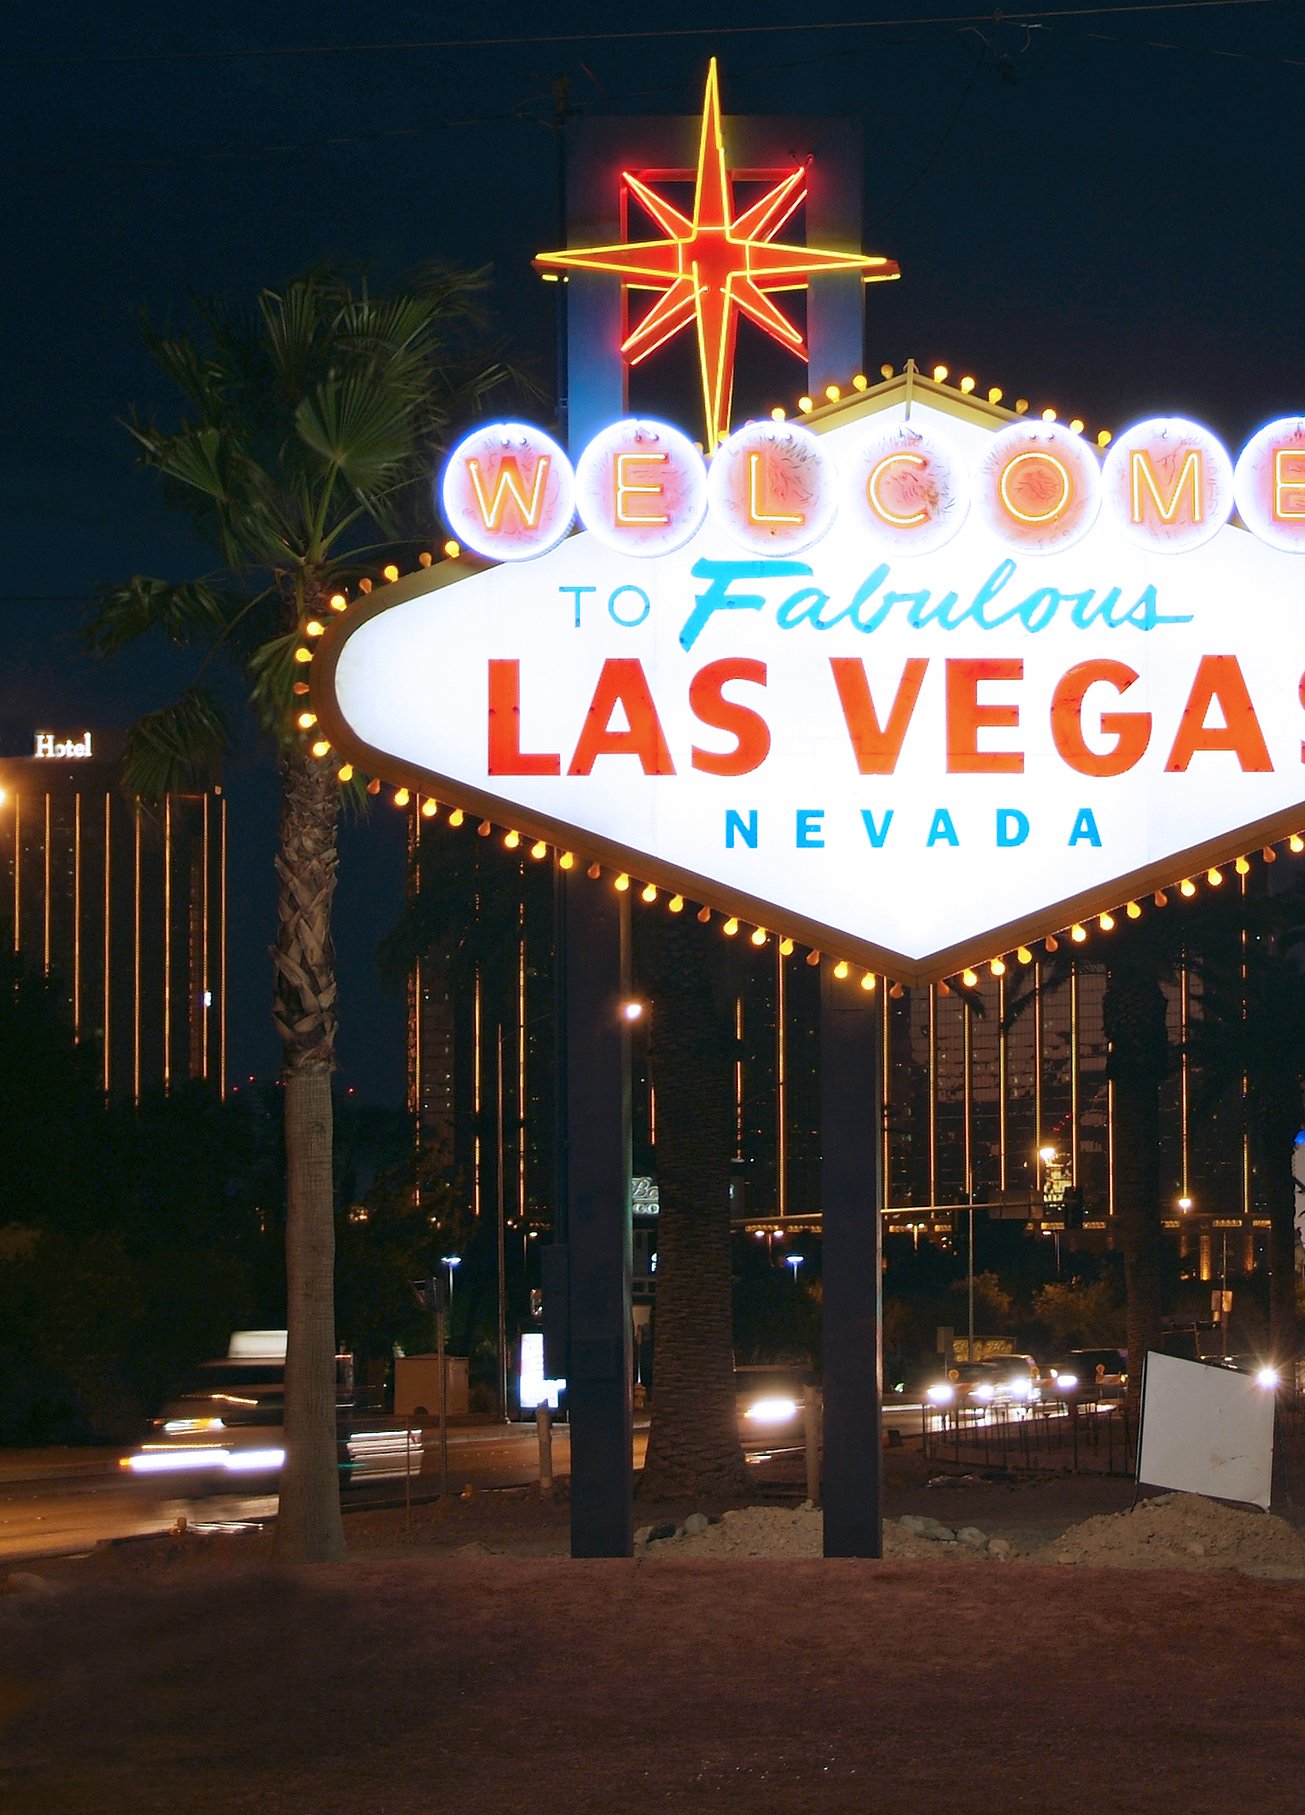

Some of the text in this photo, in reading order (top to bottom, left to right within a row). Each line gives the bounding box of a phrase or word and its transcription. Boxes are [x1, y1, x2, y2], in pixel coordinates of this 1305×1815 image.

[558, 557, 1195, 653] TO Fabulous
[34, 732, 93, 758] Hotel
[487, 656, 772, 777] LAS
[724, 807, 1103, 849] NEVADA
